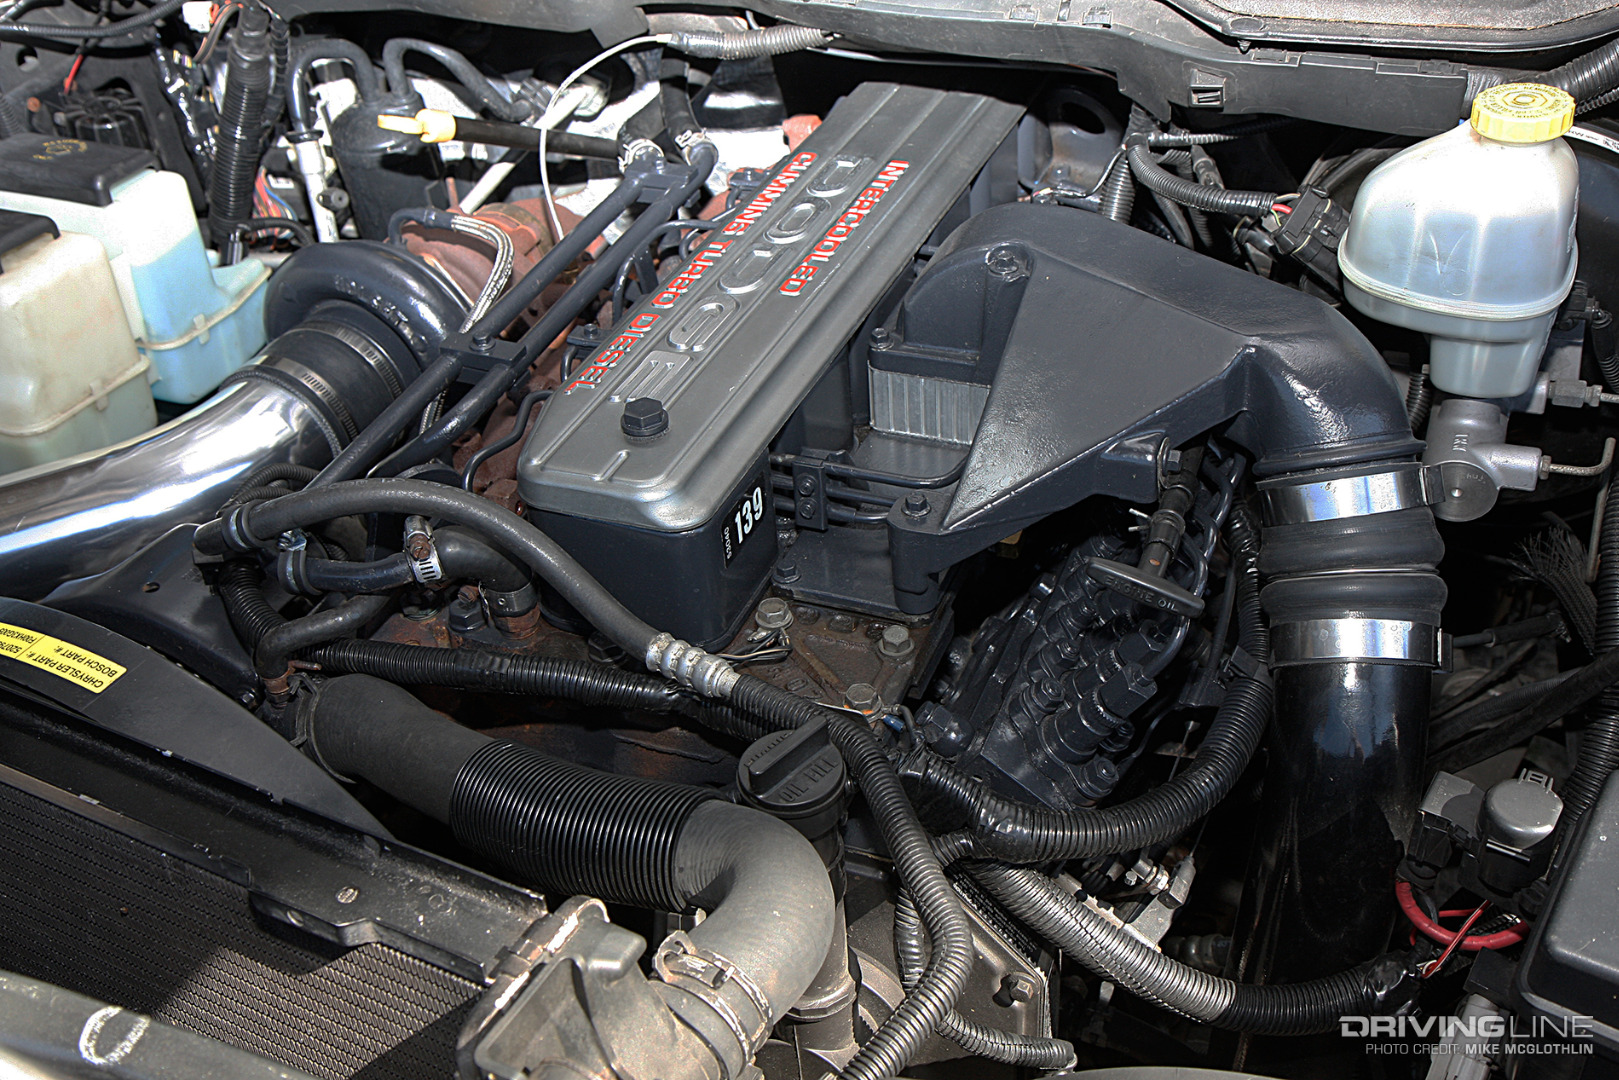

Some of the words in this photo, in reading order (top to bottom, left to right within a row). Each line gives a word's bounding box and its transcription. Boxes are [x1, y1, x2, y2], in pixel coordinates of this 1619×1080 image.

[722, 151, 818, 236] CUMMINS
[779, 159, 911, 297] INTERCOOLED
[652, 239, 738, 310] TURBO
[564, 313, 663, 397] DIESEL
[734, 486, 763, 544] 139
[1158, 599, 1179, 611] OIL
[33, 654, 57, 667] PART
[56, 664, 104, 688] CHRYSLER
[60, 649, 88, 665] PART
[84, 660, 118, 678] BOSCH
[779, 782, 809, 802] OIL
[803, 758, 839, 783] FILL
